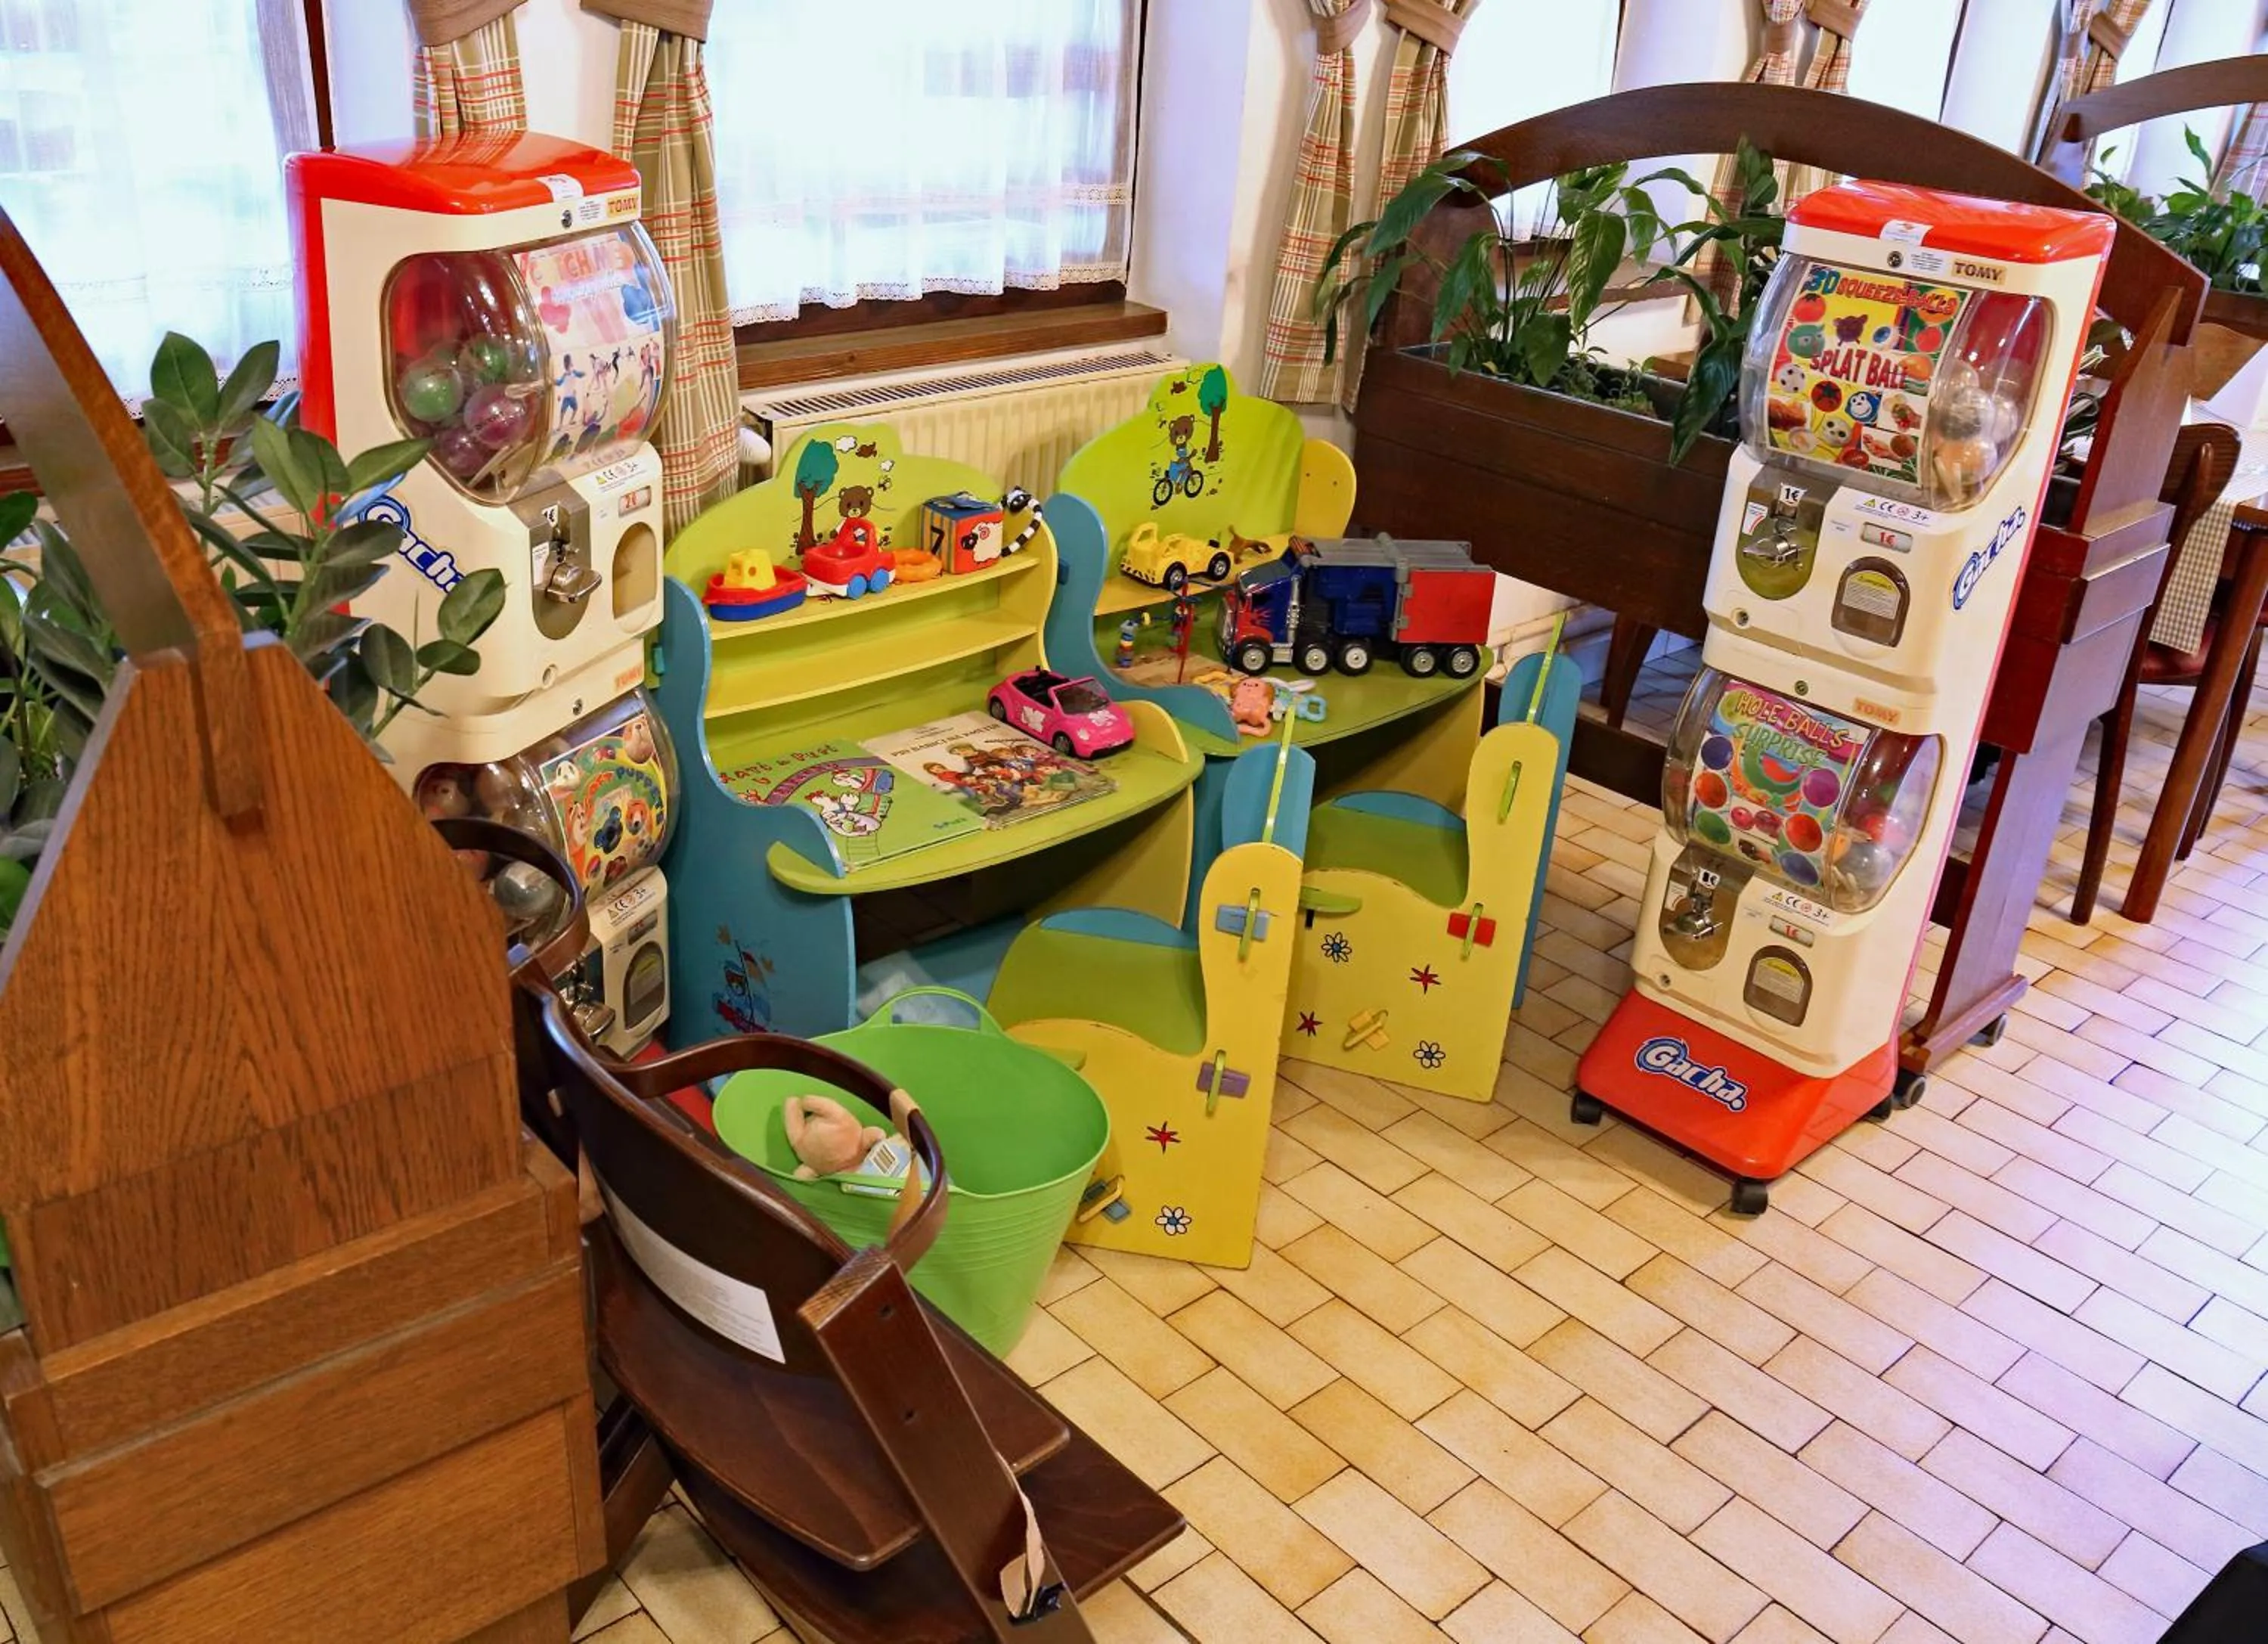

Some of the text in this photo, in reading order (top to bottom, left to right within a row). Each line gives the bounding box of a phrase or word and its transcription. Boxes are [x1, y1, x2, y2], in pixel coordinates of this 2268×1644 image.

[608, 197, 636, 213] TOMY
[1803, 264, 1841, 295] 3D
[1954, 261, 2003, 281] TOMY
[1809, 348, 1907, 389] SPLAT BALL
[1784, 488, 1799, 502] 1€
[931, 525, 945, 556] 7
[1879, 532, 1896, 546] 1€
[1734, 692, 1851, 749] HOLE BALLS
[1856, 699, 1898, 723] TOMY
[1733, 722, 1828, 766] SURPRISE
[1813, 908, 1830, 920] 3+
